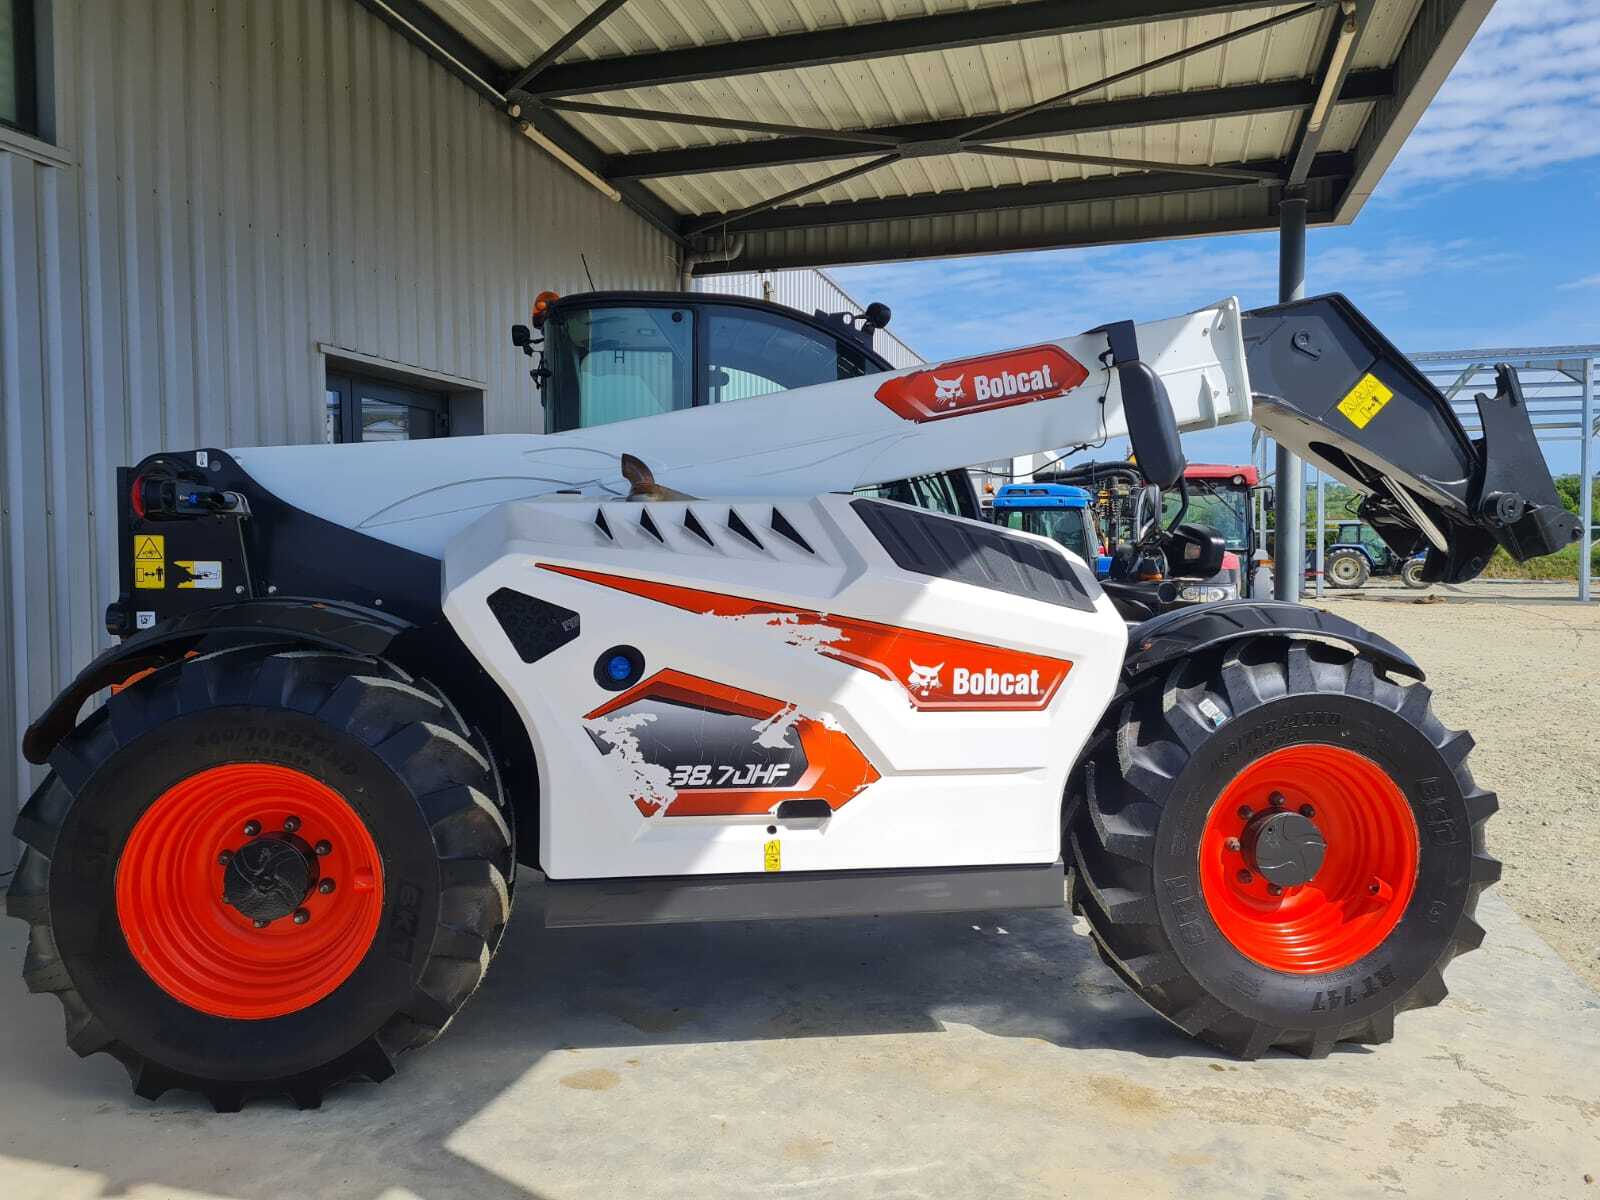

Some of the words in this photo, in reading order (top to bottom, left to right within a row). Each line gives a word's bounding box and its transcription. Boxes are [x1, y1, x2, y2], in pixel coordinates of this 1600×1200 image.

[974, 364, 1053, 400] Bobcat
[953, 667, 1040, 695] Bobcat
[671, 764, 791, 786] 38.70HF
